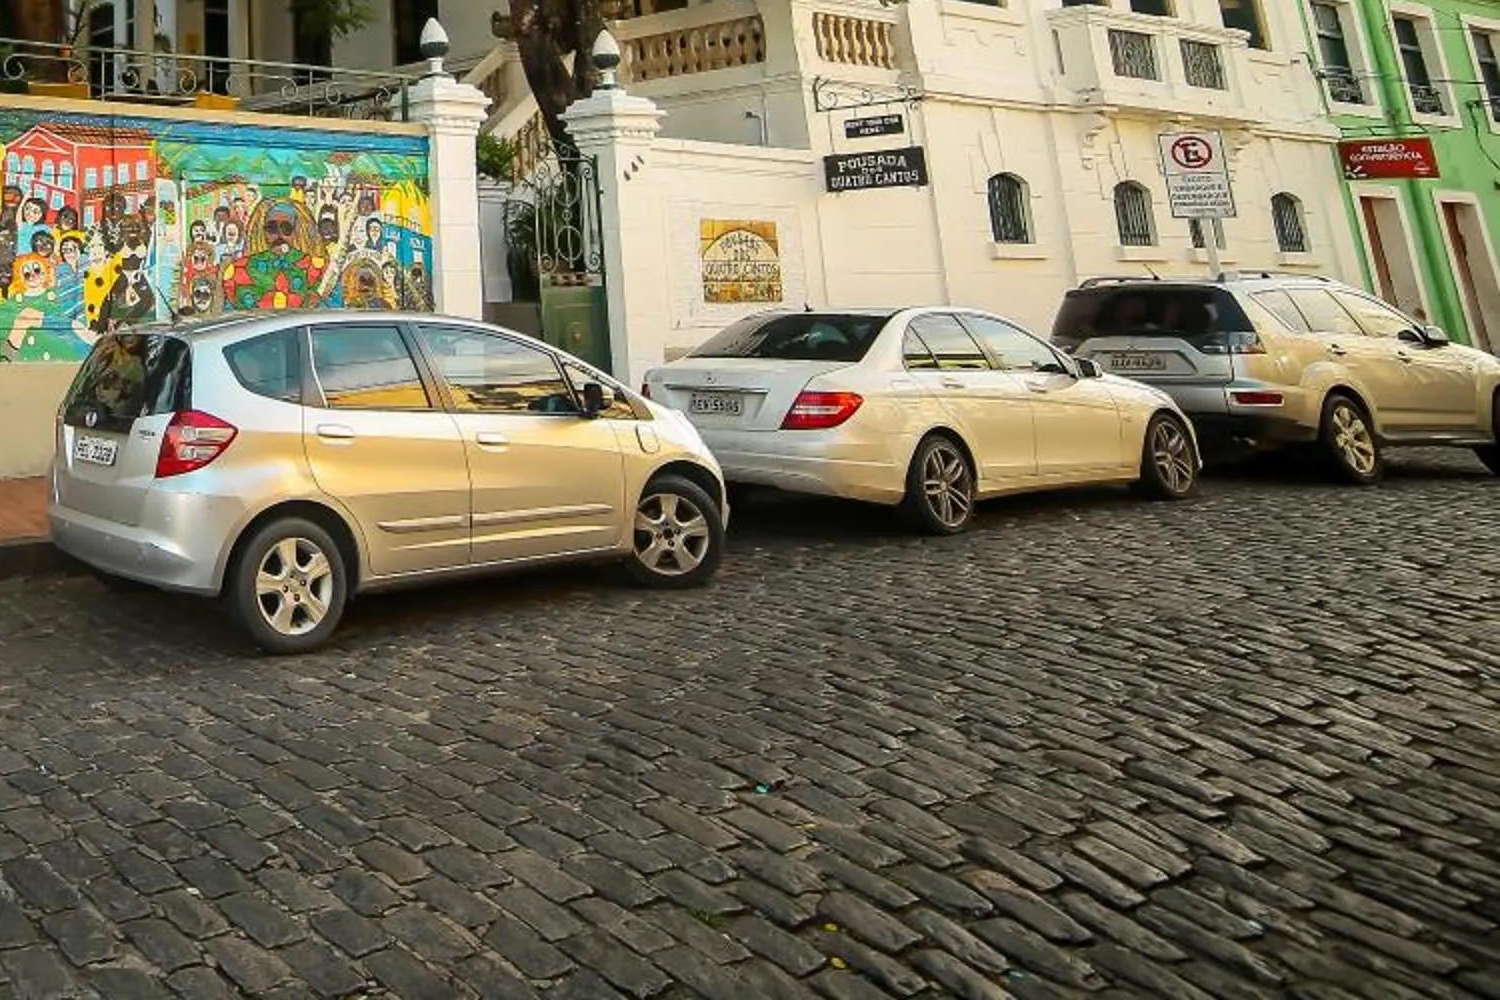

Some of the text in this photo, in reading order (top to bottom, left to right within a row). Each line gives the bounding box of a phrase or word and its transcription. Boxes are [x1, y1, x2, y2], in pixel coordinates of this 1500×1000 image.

[838, 155, 908, 173] POUSADA
[831, 169, 920, 188] QUATRO CANTOS
[743, 263, 778, 275] CANTOS
